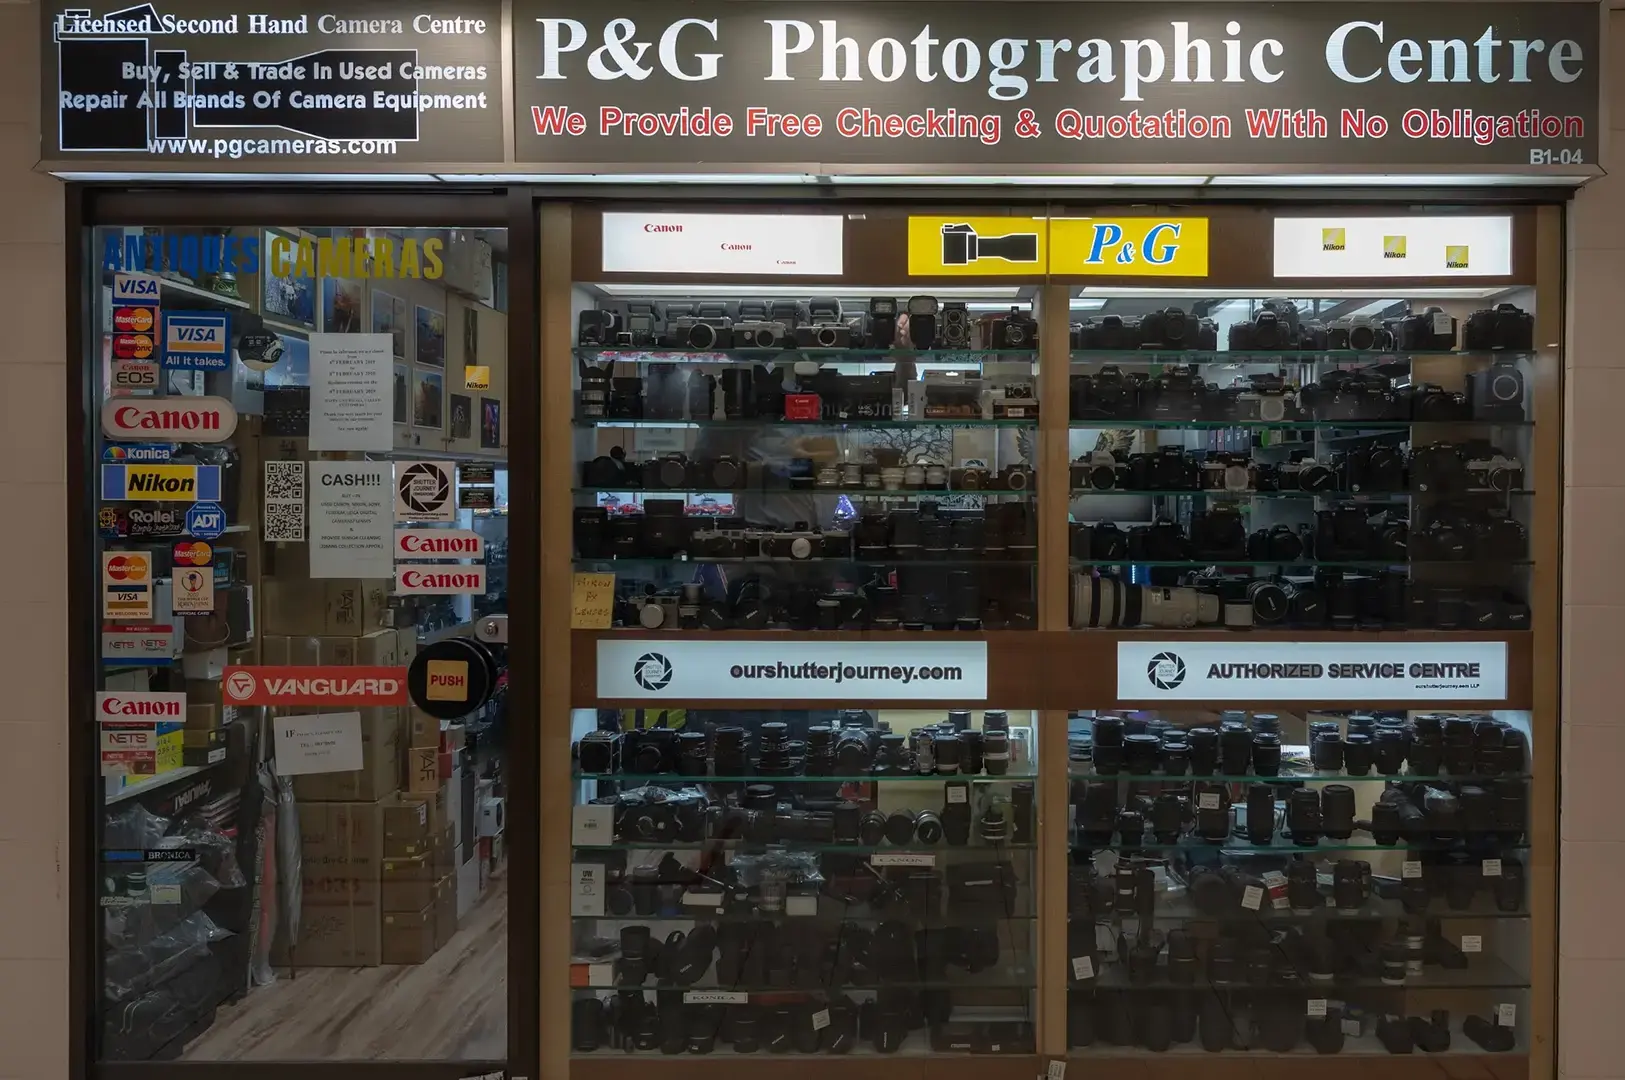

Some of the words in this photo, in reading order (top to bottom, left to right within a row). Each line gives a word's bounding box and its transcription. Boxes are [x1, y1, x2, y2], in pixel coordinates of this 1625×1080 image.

[57, 14, 150, 35] Licensed
[162, 14, 239, 35] Second
[248, 14, 308, 35] Hand
[318, 14, 403, 35] Camera
[412, 14, 486, 35] Centre
[535, 18, 724, 82] P&G
[763, 19, 1284, 102] Photographic
[1325, 20, 1584, 85] Centre
[122, 62, 171, 84] Buy,
[178, 61, 216, 82] Sell
[224, 61, 240, 82] &
[247, 61, 306, 82] Trade
[314, 61, 333, 81] In
[339, 61, 392, 82] Used
[400, 61, 487, 82] Cameras
[60, 90, 128, 113] Repair
[137, 91, 167, 110] All
[173, 91, 246, 110] Brands
[252, 91, 281, 110] Of
[289, 91, 367, 110] Camera
[373, 91, 487, 113] Equipment
[531, 105, 587, 137] We
[599, 105, 734, 138] Provide
[746, 107, 823, 138] Free
[836, 106, 1001, 145] Checking
[1014, 107, 1042, 138] &
[1055, 108, 1231, 140] Quotation
[1245, 107, 1328, 139] With
[1340, 108, 1389, 139] No
[1402, 107, 1584, 146] Obligation
[148, 138, 398, 160] www.pgcameras.com
[1529, 149, 1584, 165] B1-04
[643, 223, 683, 233] Canon
[720, 242, 752, 251] Canon
[1083, 222, 1183, 266] P&G
[1323, 243, 1345, 251] Nikon
[104, 235, 259, 278] ANTIQUES
[271, 236, 444, 280] CAMERAS
[1383, 250, 1407, 259] Nikon
[1446, 260, 1469, 269] Nikon
[119, 280, 158, 295] VISA
[115, 315, 153, 324] MasterCard
[175, 328, 215, 341] VISA
[165, 355, 182, 365] All
[183, 355, 192, 365] it
[194, 356, 226, 367] takes.
[116, 372, 154, 384] EOS
[465, 381, 489, 390] Nikon
[114, 406, 220, 430] Canon
[127, 447, 170, 460] Konica
[128, 473, 195, 492] Nikon
[321, 473, 381, 486] CASH!!!
[127, 508, 175, 523] Rollei
[193, 514, 220, 529] ADT
[400, 535, 478, 552] Canon
[174, 550, 211, 558] MasterCard
[108, 564, 146, 573] MasterCard
[402, 570, 480, 588] Canon
[117, 593, 138, 601] VISA
[109, 641, 135, 649] NETS
[141, 639, 167, 647] NETS
[729, 661, 963, 684] ourshutterjourney.com
[1206, 663, 1324, 679] AUTHORIZED
[1327, 663, 1405, 679] SERVICE
[1408, 663, 1481, 679] CENTRE
[263, 677, 399, 696] VANGUARD
[430, 674, 464, 686] PUSH
[102, 698, 180, 715] Canon
[109, 733, 147, 743] NETS
[148, 851, 191, 860] BRONICA
